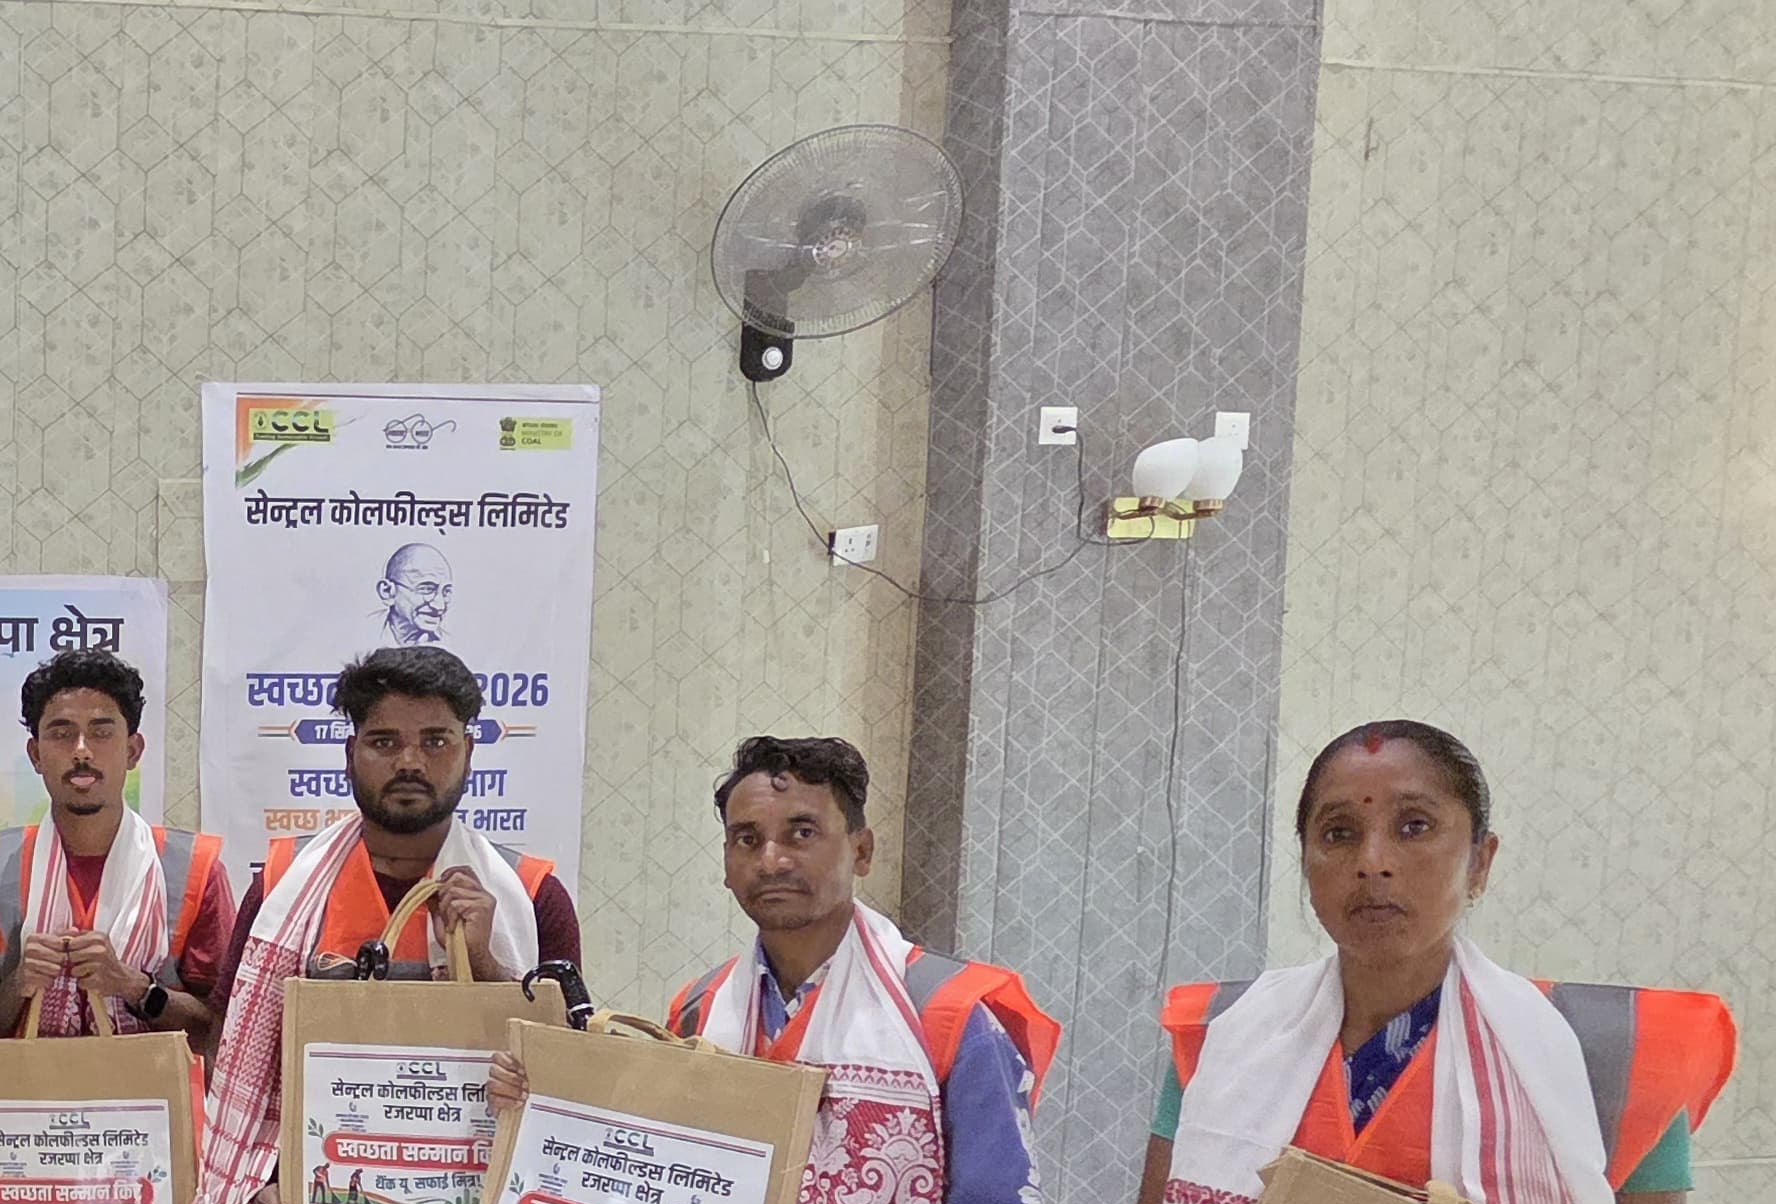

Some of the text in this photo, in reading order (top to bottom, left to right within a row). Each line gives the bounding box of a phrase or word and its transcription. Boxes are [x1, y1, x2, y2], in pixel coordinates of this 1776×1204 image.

[271, 410, 329, 434] CCL
[244, 488, 570, 536] सेन्ट्रल कोलफील्ड्स लिमिटेड
[49, 604, 124, 653] क्षेत्र
[314, 725, 329, 740] 17
[264, 808, 321, 832] स्वच्छ
[473, 808, 528, 832] भारत
[408, 1061, 446, 1076] CCL
[331, 1077, 374, 1099] सेन्ट्रल
[58, 1112, 91, 1126] CCL
[383, 1102, 462, 1123] रजरप्पा क्षेत्र
[103, 1128, 149, 1147] लिमिटेड
[614, 1128, 655, 1149] CCL
[38, 1147, 104, 1166] रजरप्पा क्षेत्र
[336, 1138, 399, 1161] स्वच्छता
[400, 1142, 471, 1163] सम्मान
[542, 1136, 582, 1162] सेन्ट्रल
[667, 1163, 735, 1197] लिमिटेड
[55, 1183, 111, 1202] सम्मान
[398, 1177, 412, 1194] यू
[413, 1172, 450, 1190] सफाई
